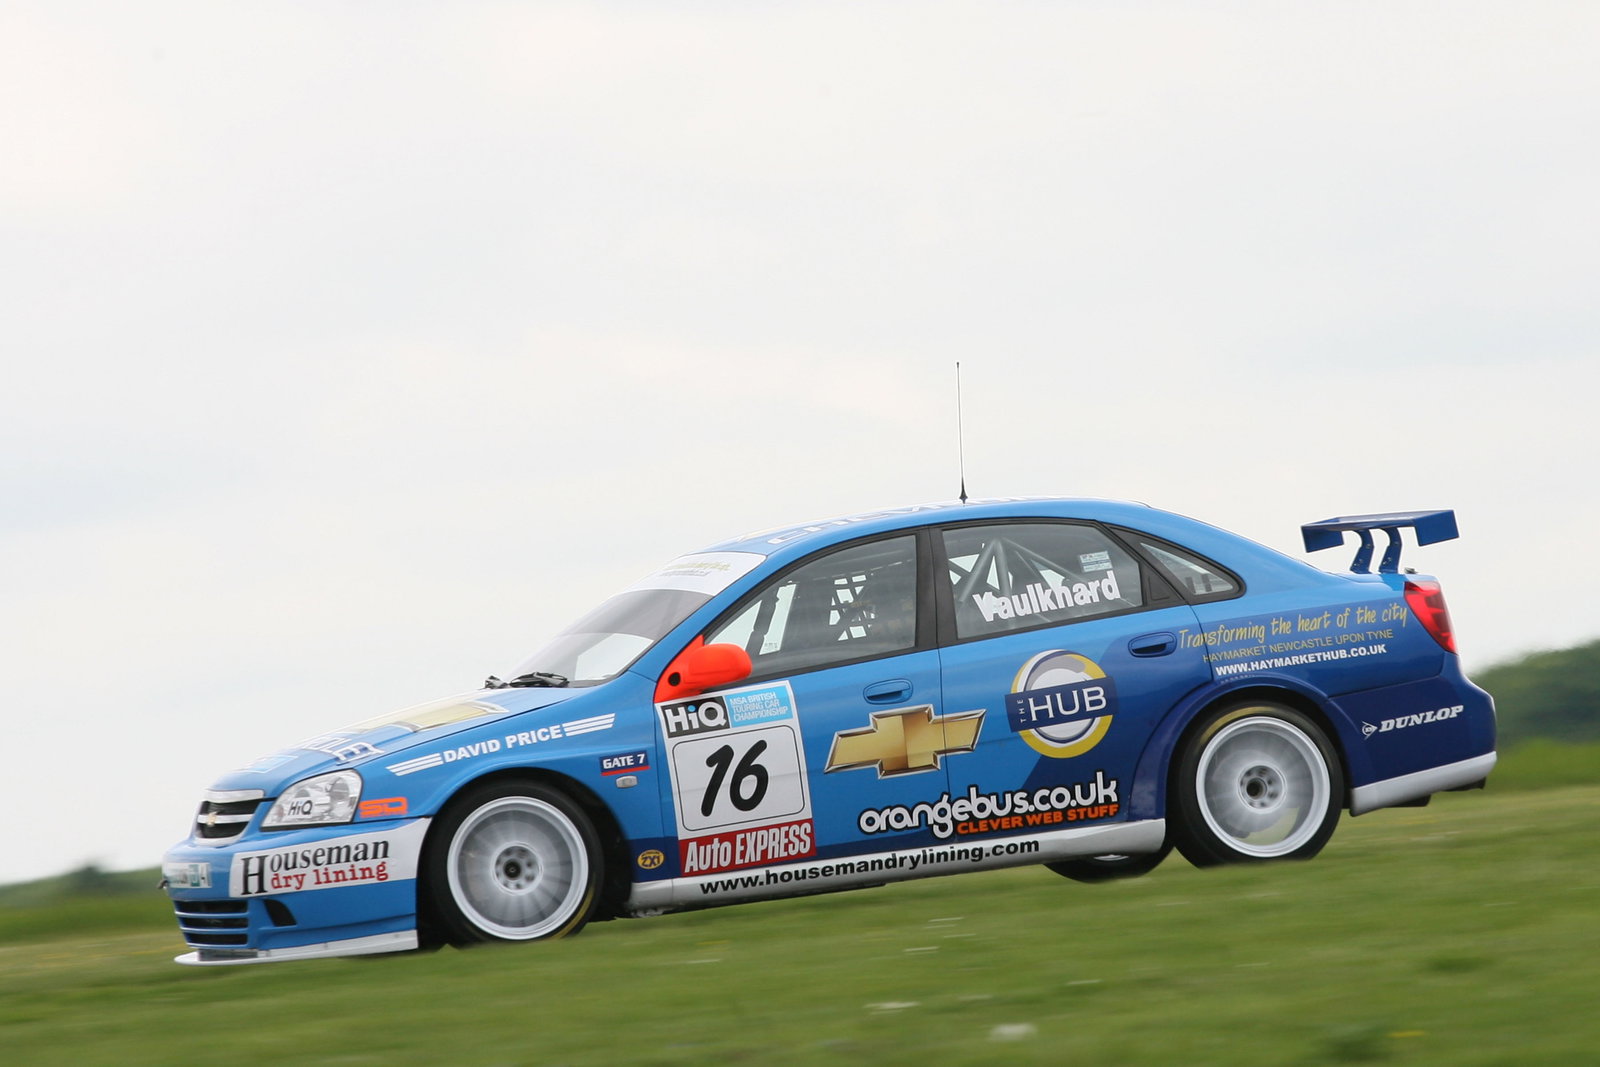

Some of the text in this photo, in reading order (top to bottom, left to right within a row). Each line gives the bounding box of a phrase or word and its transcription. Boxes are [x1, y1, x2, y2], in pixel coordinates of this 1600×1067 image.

[972, 570, 1120, 622] Vaulkhard
[1179, 602, 1408, 647] Transforming the heart of the city
[1203, 628, 1394, 662] HAYMARKET NEWCASTLE UPON TYNE
[1215, 643, 1387, 677] WWW.HAYMARKETHUB.CO.UK
[733, 699, 780, 713] TOURING CAR
[733, 705, 789, 722] CHAMPIONSHIP
[747, 691, 777, 703] BRITISH
[1017, 686, 1107, 723] THE HUB
[665, 701, 727, 733] HiQ
[1379, 705, 1464, 733] DUNLOP
[443, 725, 565, 764] DAVID PRICE
[603, 753, 646, 769] GATE 7
[701, 739, 769, 817] 16
[287, 800, 313, 816] HiQ
[859, 771, 1118, 839] orangebus.co.uk
[957, 804, 1119, 835] CLEVER WEB STUFF
[684, 822, 812, 873] Auto EXPRESS
[240, 839, 389, 895] Houseman
[270, 861, 389, 890] dry lining
[700, 840, 1040, 894] www.housemandrylining.com
